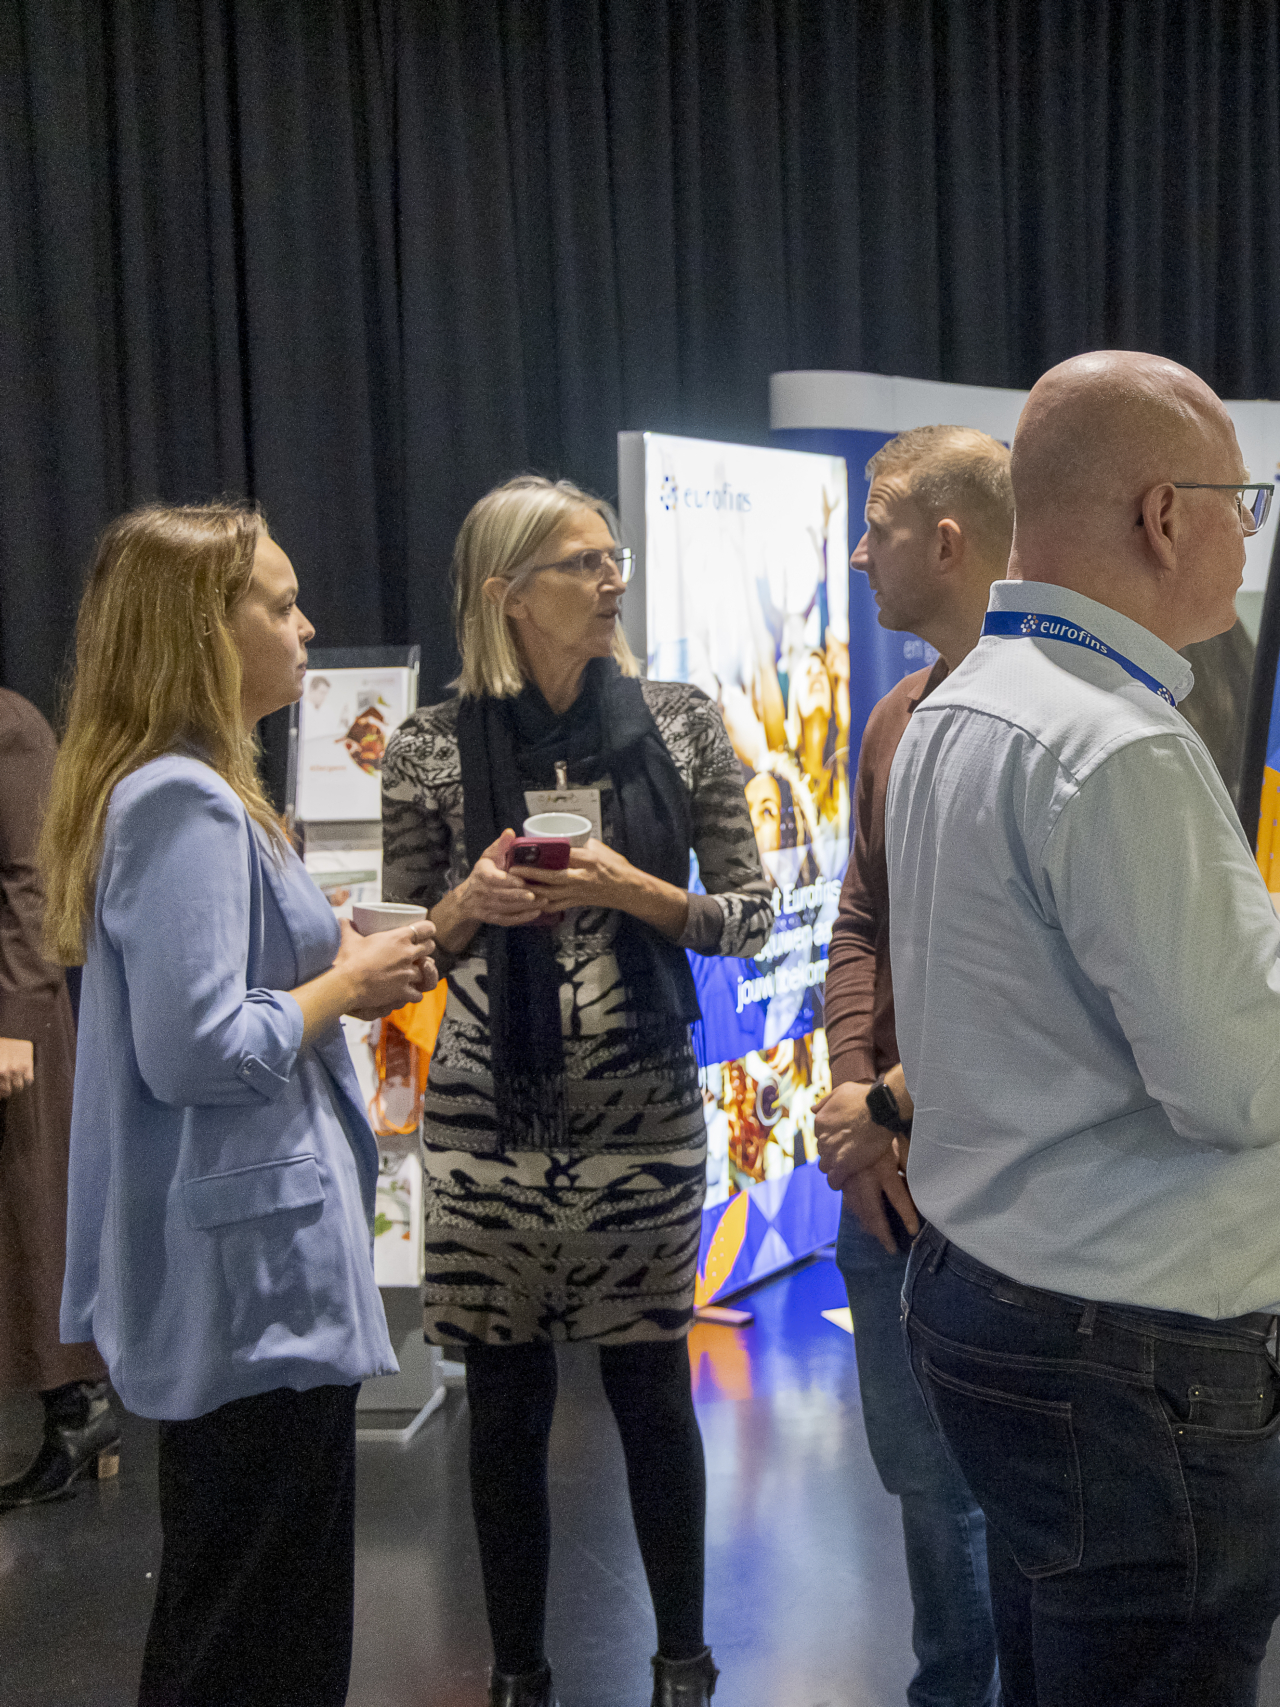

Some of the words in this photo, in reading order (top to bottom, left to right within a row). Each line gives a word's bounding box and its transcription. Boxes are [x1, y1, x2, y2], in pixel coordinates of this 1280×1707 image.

[683, 481, 753, 513] eurofins
[1040, 620, 1108, 654] eurofins
[782, 876, 842, 915] Eurofins
[754, 923, 813, 961] ouwen
[812, 920, 834, 947] aa
[736, 972, 775, 1014] jouw
